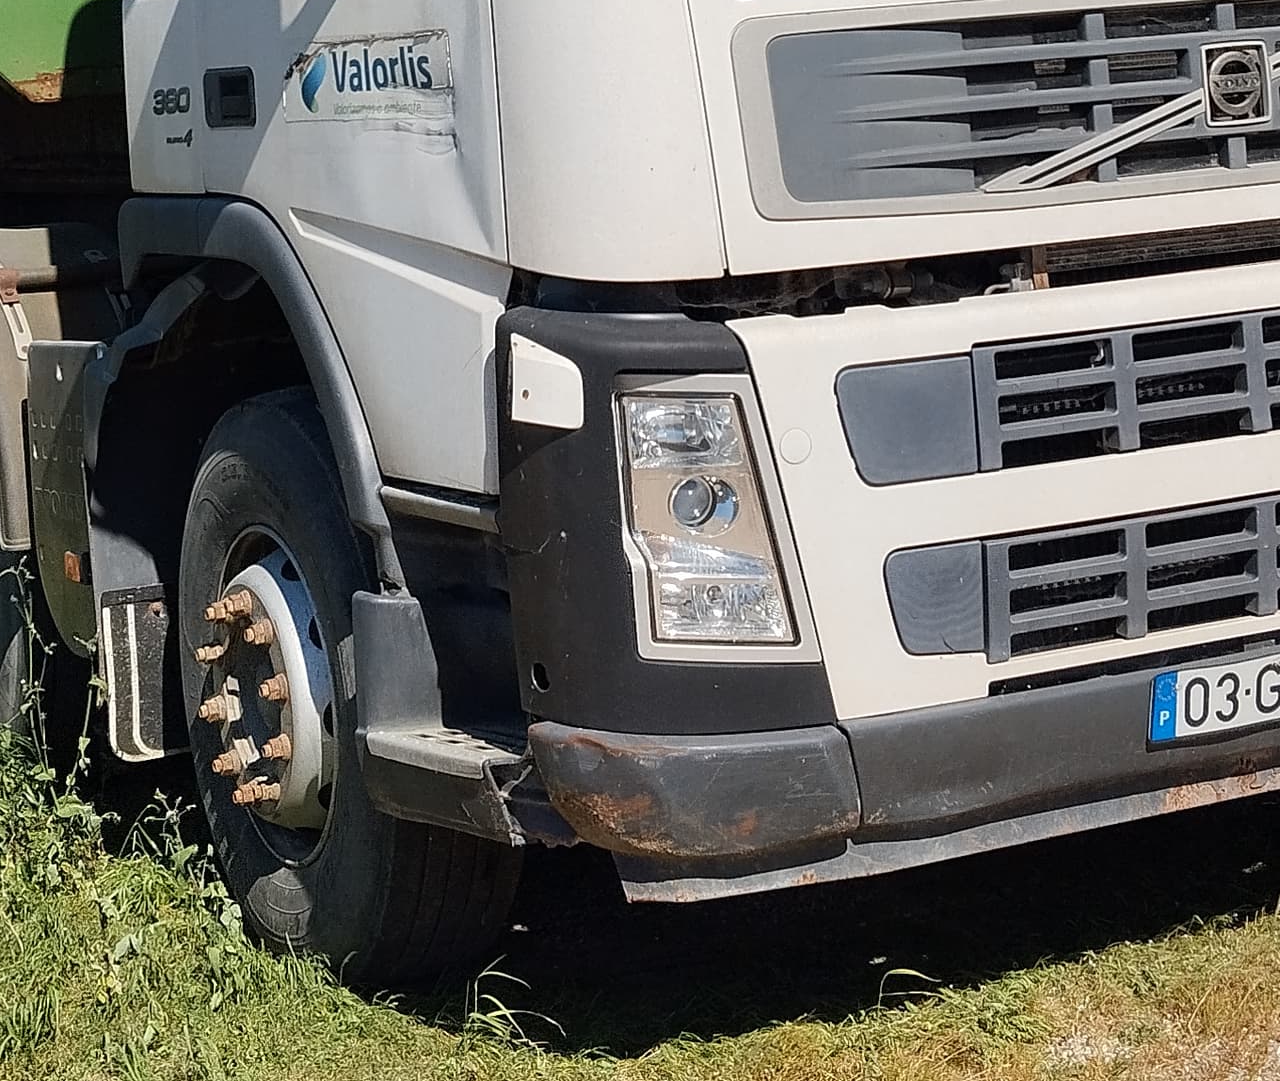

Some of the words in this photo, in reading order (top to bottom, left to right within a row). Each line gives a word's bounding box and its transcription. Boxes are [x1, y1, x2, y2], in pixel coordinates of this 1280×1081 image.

[332, 46, 433, 94] Valorlis
[1213, 77, 1259, 88] VOLVO
[1159, 711, 1170, 726] P
